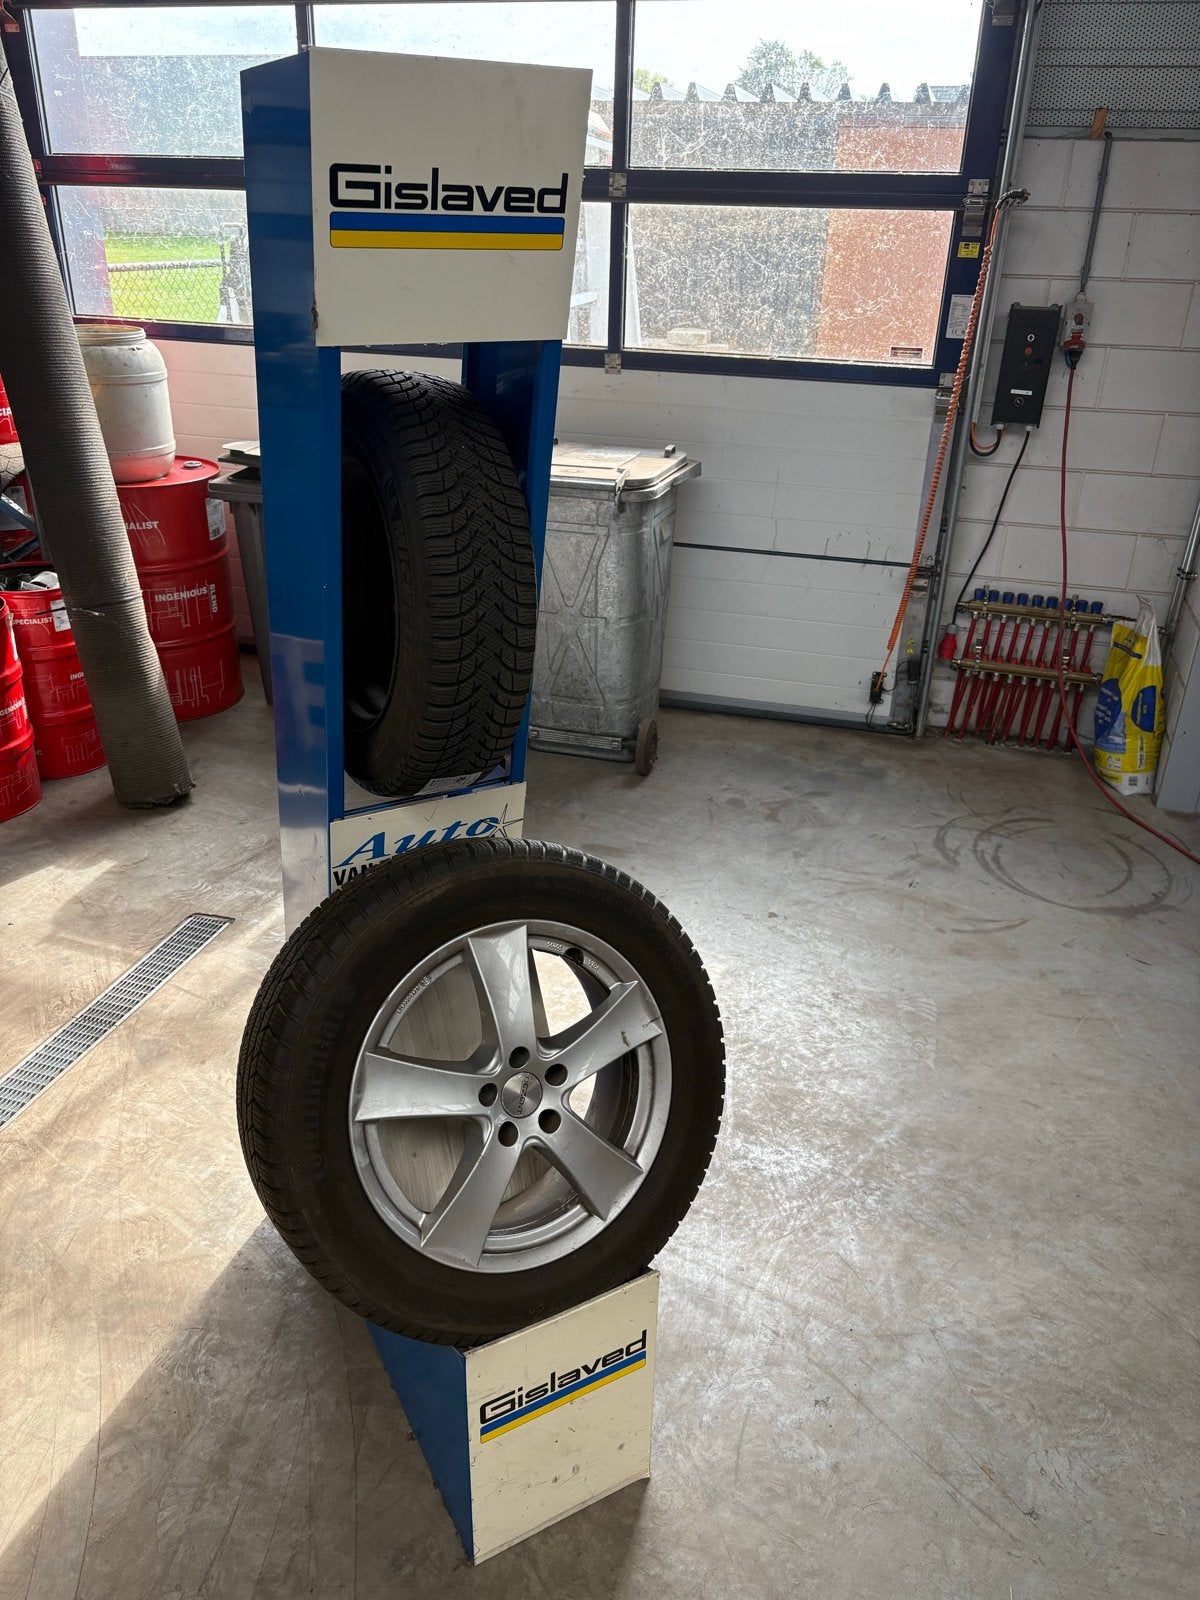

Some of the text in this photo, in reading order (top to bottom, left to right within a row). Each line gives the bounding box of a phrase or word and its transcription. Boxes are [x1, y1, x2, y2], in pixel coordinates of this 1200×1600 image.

[329, 163, 569, 214] Gislaved
[154, 586, 208, 603] INGENIOUS
[210, 583, 219, 613] BLEND
[332, 816, 499, 869] Auto
[480, 1329, 648, 1425] Gislaved
